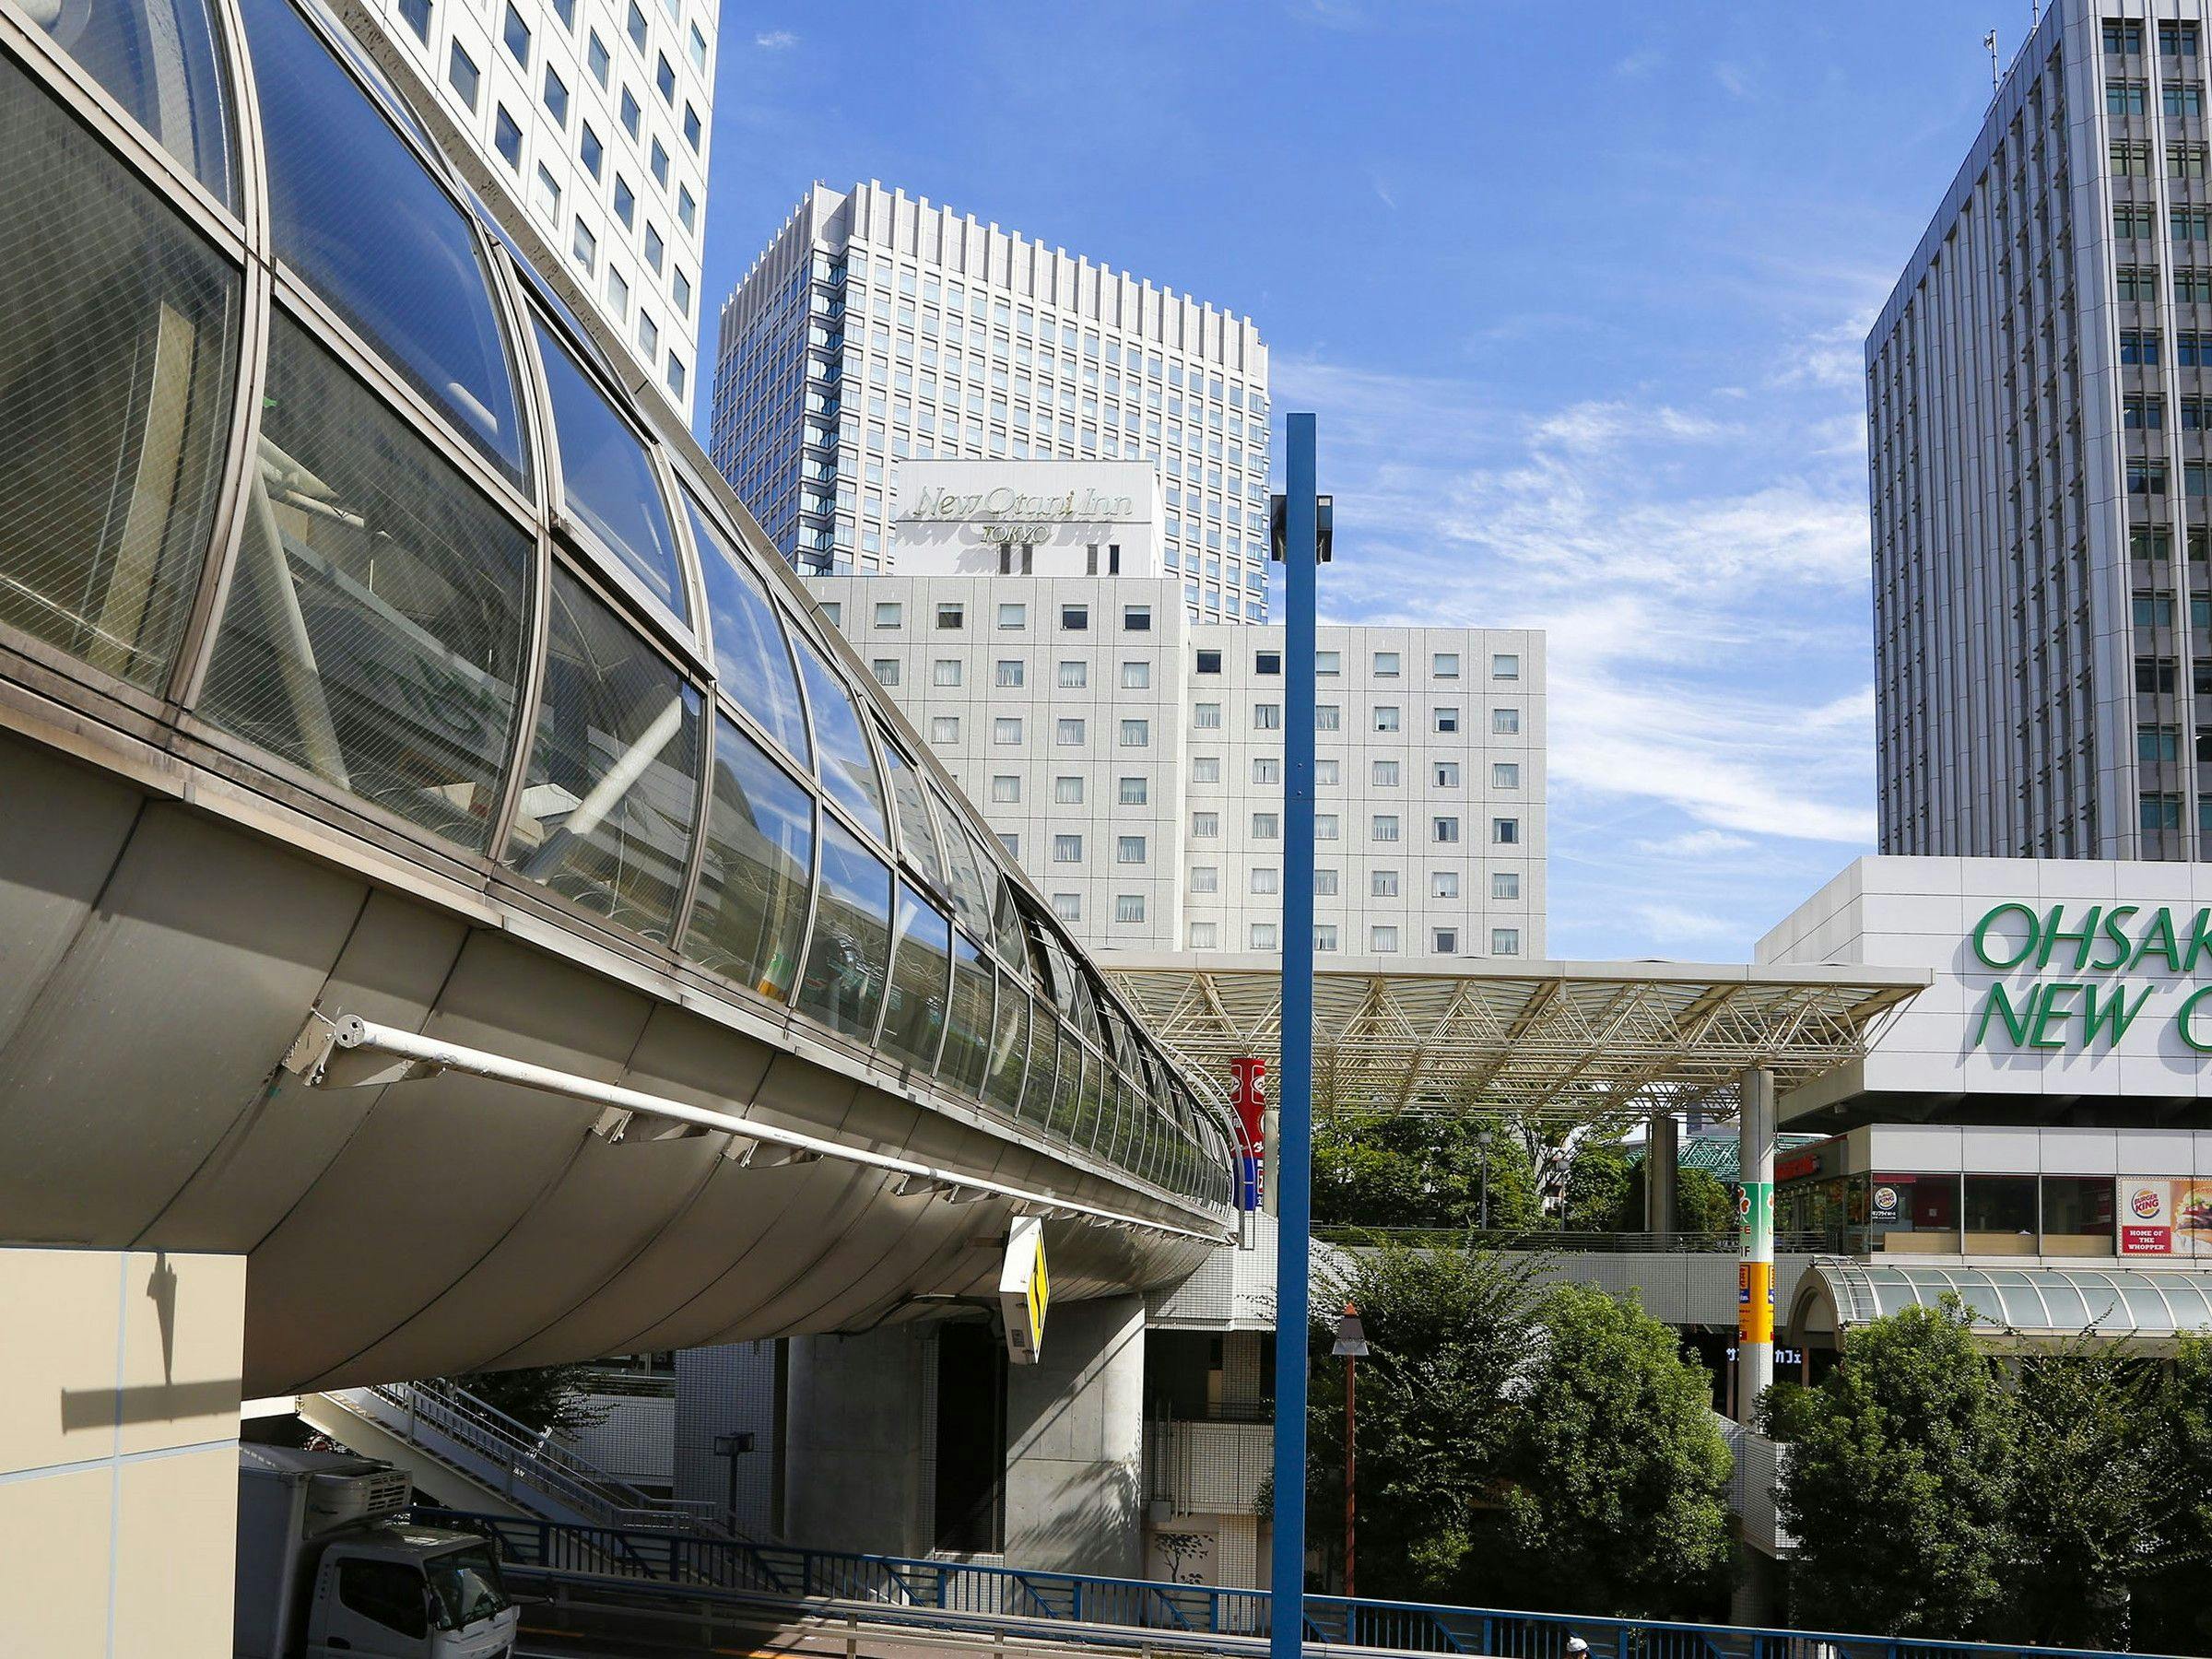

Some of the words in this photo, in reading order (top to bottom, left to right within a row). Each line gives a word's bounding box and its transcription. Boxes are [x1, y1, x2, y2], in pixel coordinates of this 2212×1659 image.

[912, 486, 982, 516] New
[986, 487, 1074, 515] Otani
[1077, 488, 1133, 516] Inn
[981, 526, 1049, 544] TOKYO
[1975, 982, 2155, 1047] NEW
[2134, 1193, 2158, 1205] BURGER
[2136, 1199, 2159, 1212] KING
